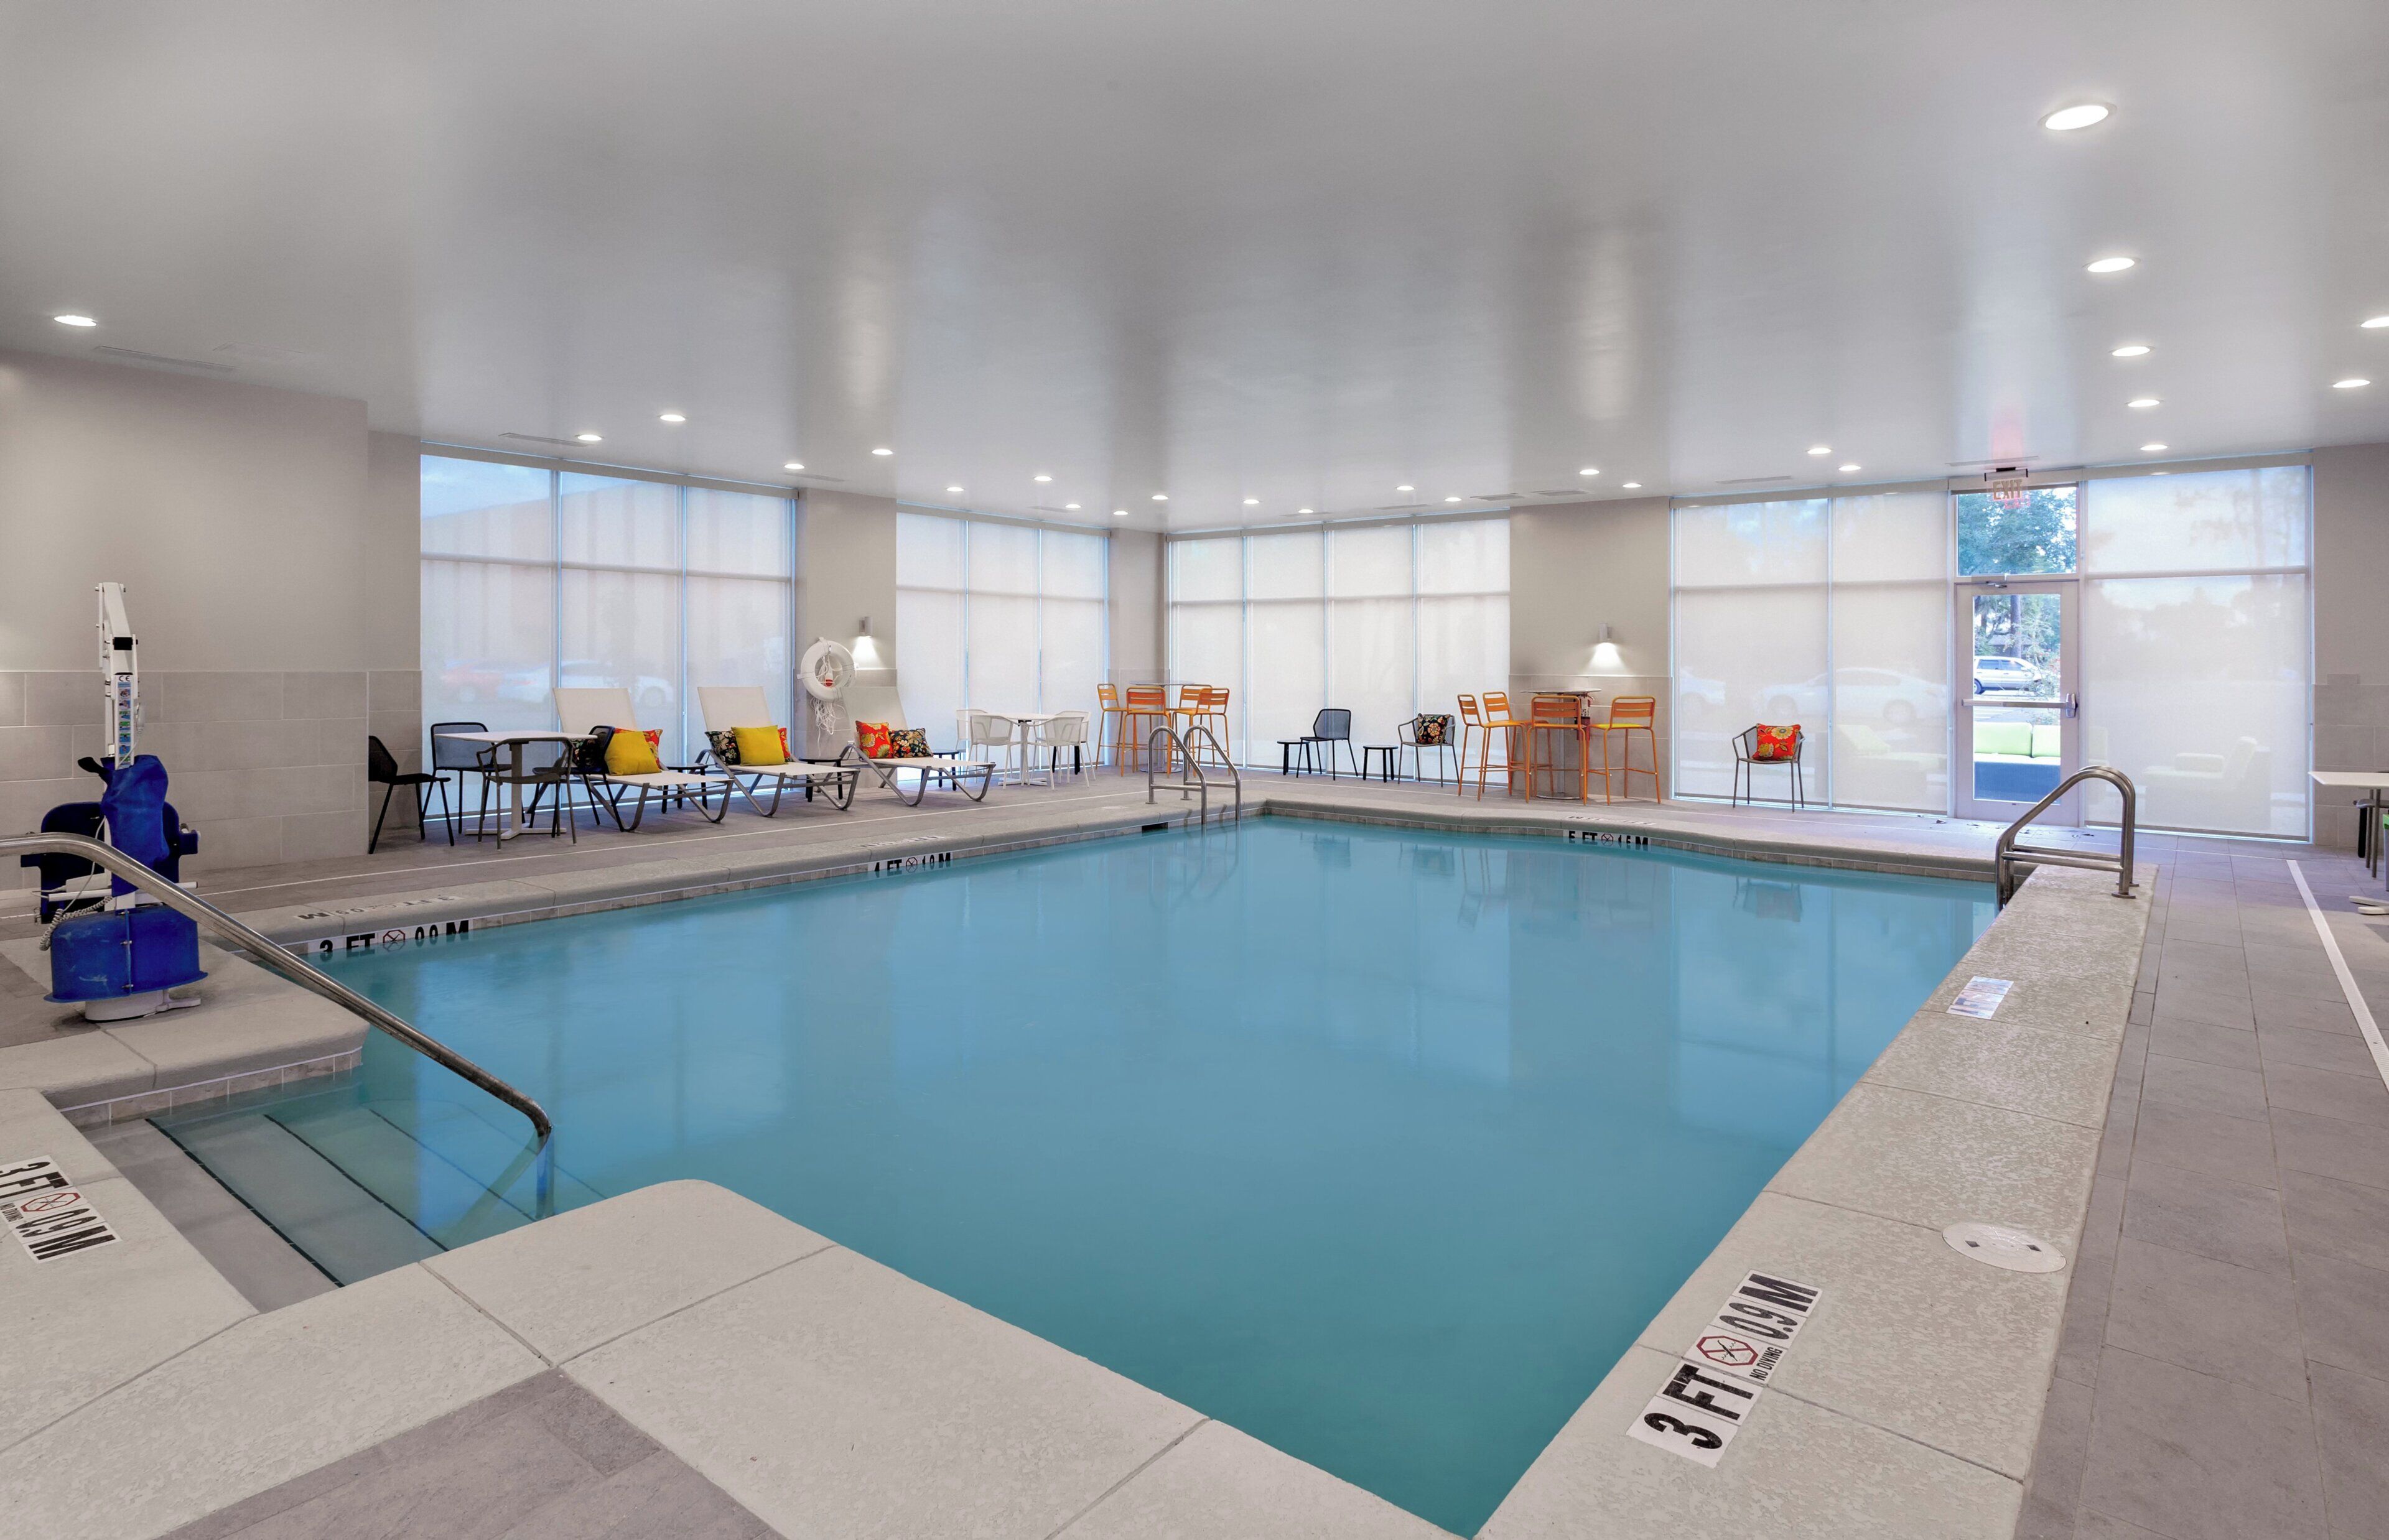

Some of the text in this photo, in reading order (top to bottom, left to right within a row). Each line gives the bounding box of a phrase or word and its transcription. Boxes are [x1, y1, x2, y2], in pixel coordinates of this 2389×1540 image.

[1993, 479, 2022, 500] EXIT
[1582, 832, 1598, 840] FT
[887, 859, 901, 871] FT
[347, 933, 375, 949] FT
[446, 920, 469, 935] M
[0, 1161, 116, 1260] 3 FT 0.9 M
[1644, 1273, 1819, 1449] 3 FT 0.9 M
[1749, 1347, 1783, 1381] NO DIVING
